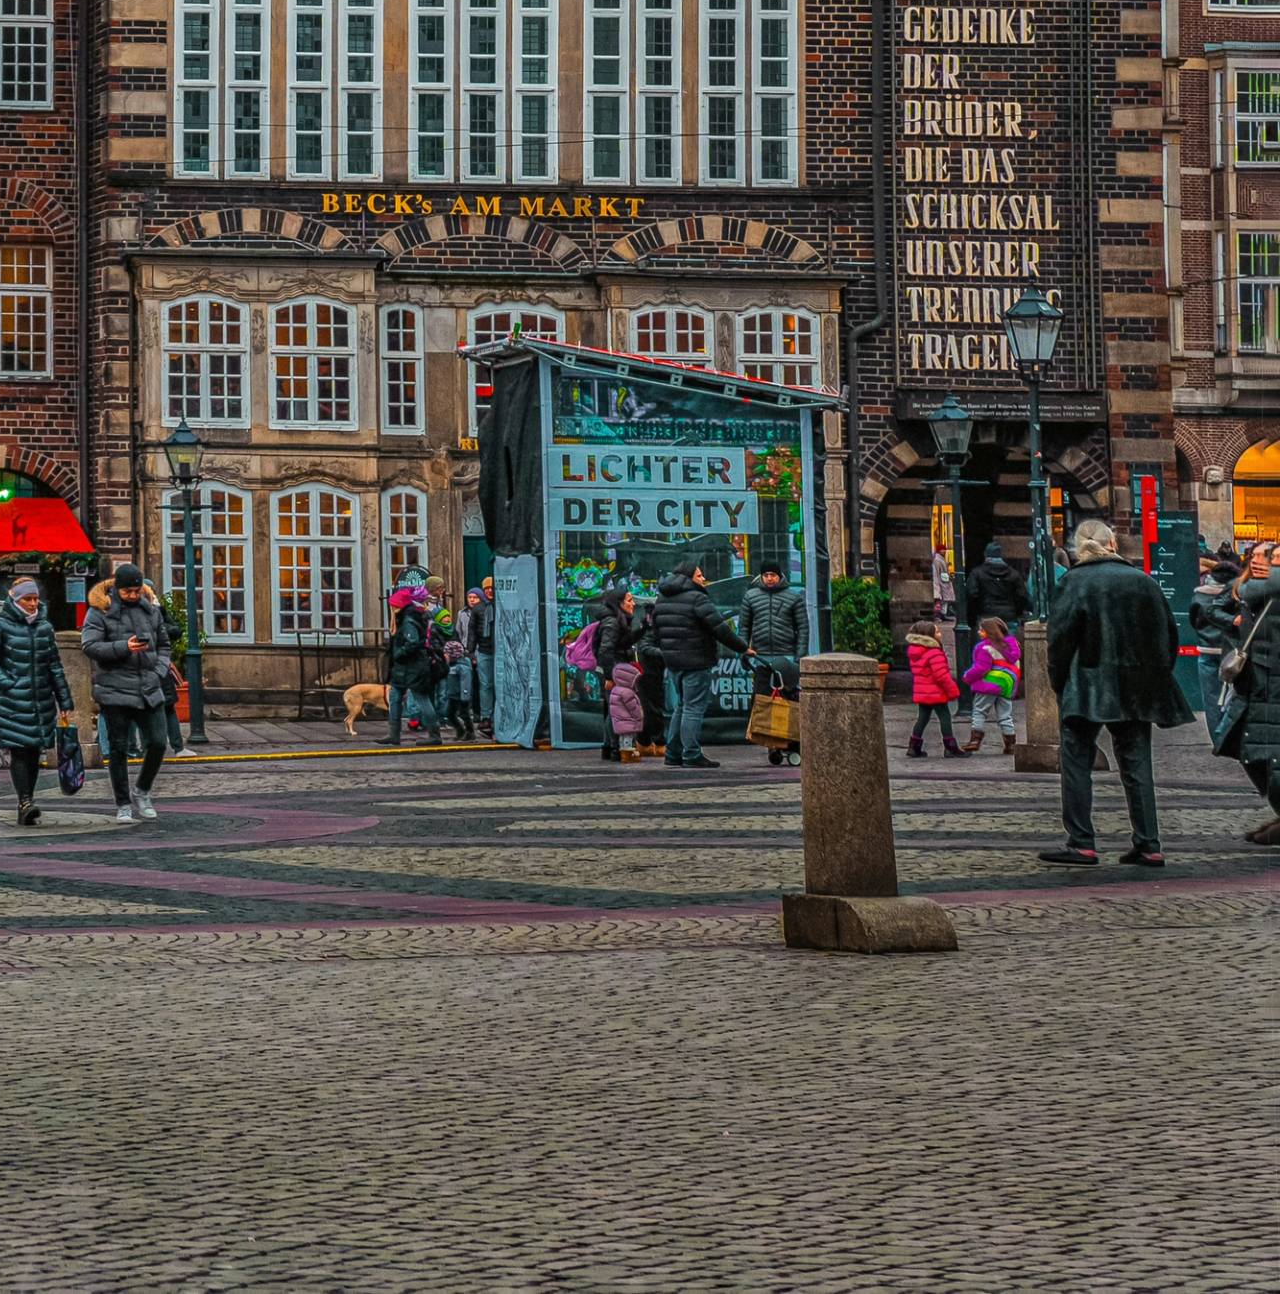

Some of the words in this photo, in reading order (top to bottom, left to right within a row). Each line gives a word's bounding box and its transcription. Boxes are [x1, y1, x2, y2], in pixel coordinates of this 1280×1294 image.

[903, 6, 1036, 44] GEDENKE
[903, 53, 960, 89] DER
[903, 93, 1038, 140] BRÜDER,
[904, 147, 951, 182] DIE
[962, 148, 1015, 183] DAS
[449, 195, 502, 216] AM
[519, 196, 645, 218] MARKT
[904, 193, 1060, 230] SCHICKSAL
[905, 239, 1040, 277] UNSERER
[562, 454, 732, 484] LICHTER
[563, 497, 641, 527] DER
[656, 499, 746, 528] CITY
